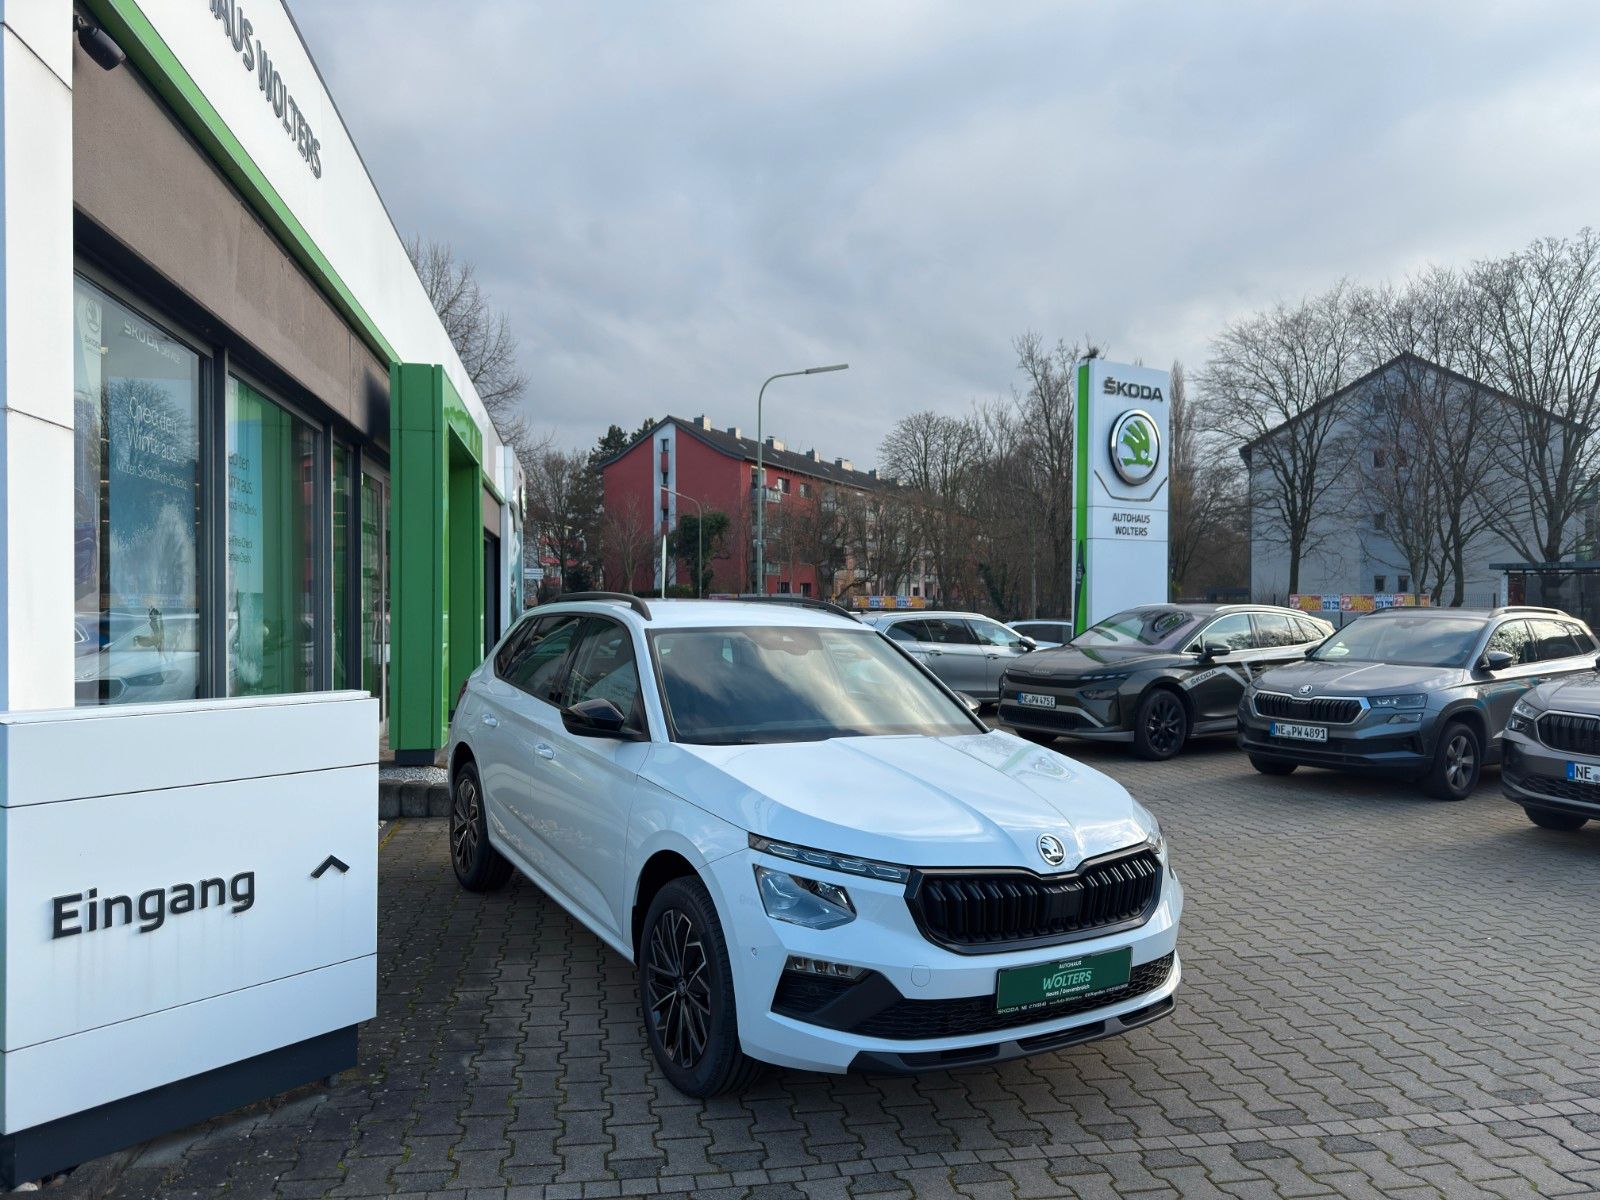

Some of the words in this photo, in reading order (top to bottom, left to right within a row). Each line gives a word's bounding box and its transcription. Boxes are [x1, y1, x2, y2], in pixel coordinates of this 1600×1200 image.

[209, 0, 255, 72] AUS
[256, 40, 322, 180] WOLTERS
[1103, 376, 1164, 402] ŠKODA
[1112, 512, 1151, 524] AUTOHAUS
[1115, 525, 1148, 536] WOLTERS
[1275, 724, 1286, 735] NE
[1291, 726, 1303, 737] PW
[1304, 727, 1326, 739] 4891
[1575, 765, 1592, 780] NE
[52, 871, 255, 939] Eingang
[1058, 960, 1082, 969] AUTOHAUS
[1043, 969, 1093, 991] WOLTERS
